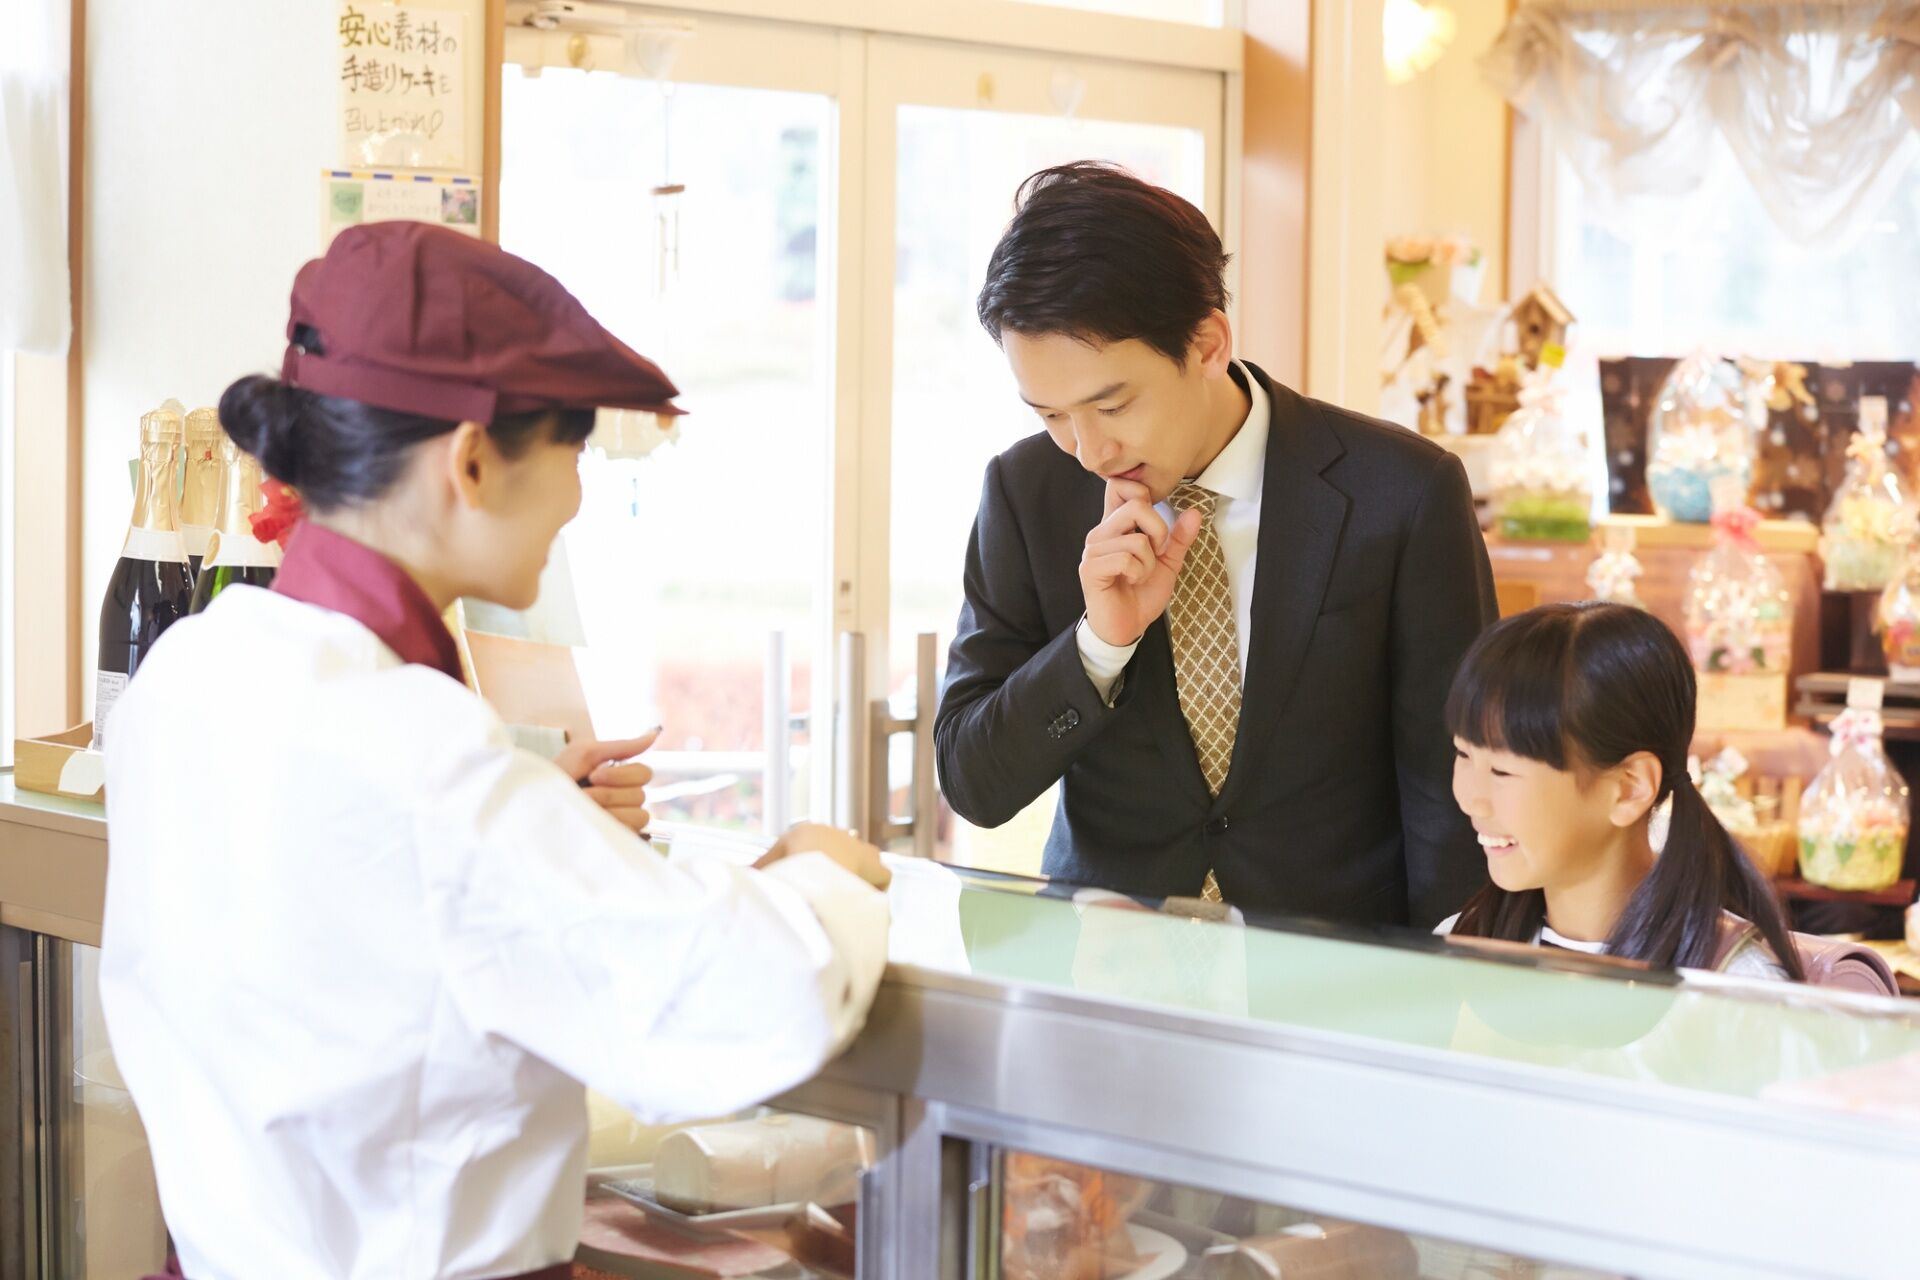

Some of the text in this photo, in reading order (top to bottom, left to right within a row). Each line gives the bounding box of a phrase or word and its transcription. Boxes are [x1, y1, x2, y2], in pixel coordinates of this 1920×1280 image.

[339, 5, 457, 55] 安心素材の
